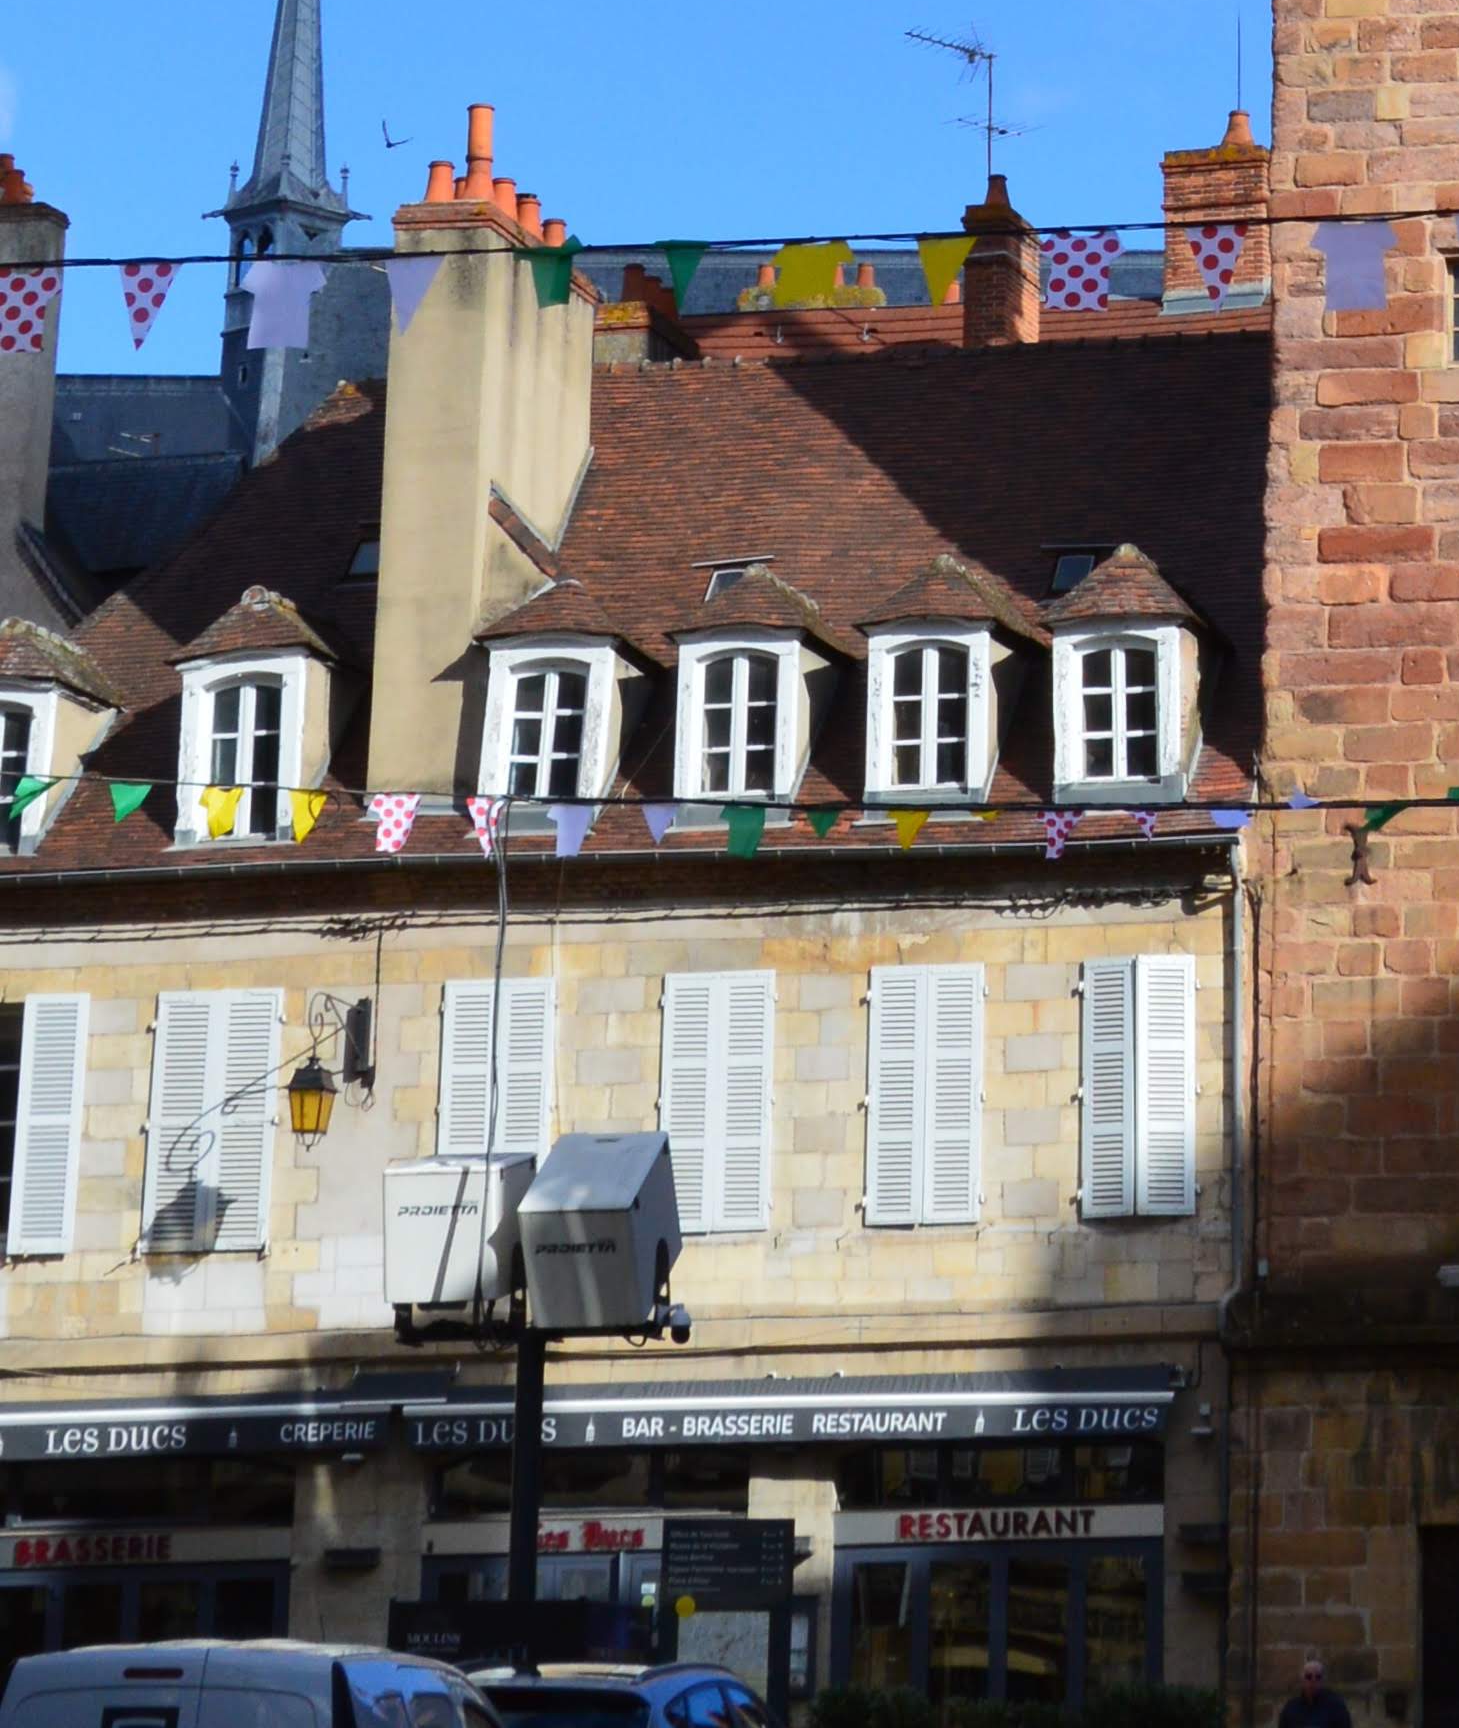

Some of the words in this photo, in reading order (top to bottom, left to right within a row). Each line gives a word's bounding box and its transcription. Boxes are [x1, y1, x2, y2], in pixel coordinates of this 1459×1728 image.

[280, 1420, 376, 1443] CREPERIE
[622, 1417, 663, 1438] BAR
[682, 1413, 794, 1437] BRASSERIE
[812, 1411, 947, 1434] RESTAURANT
[897, 1509, 1096, 1540] RESTAURANT
[15, 1533, 172, 1567] BRASSERIE
